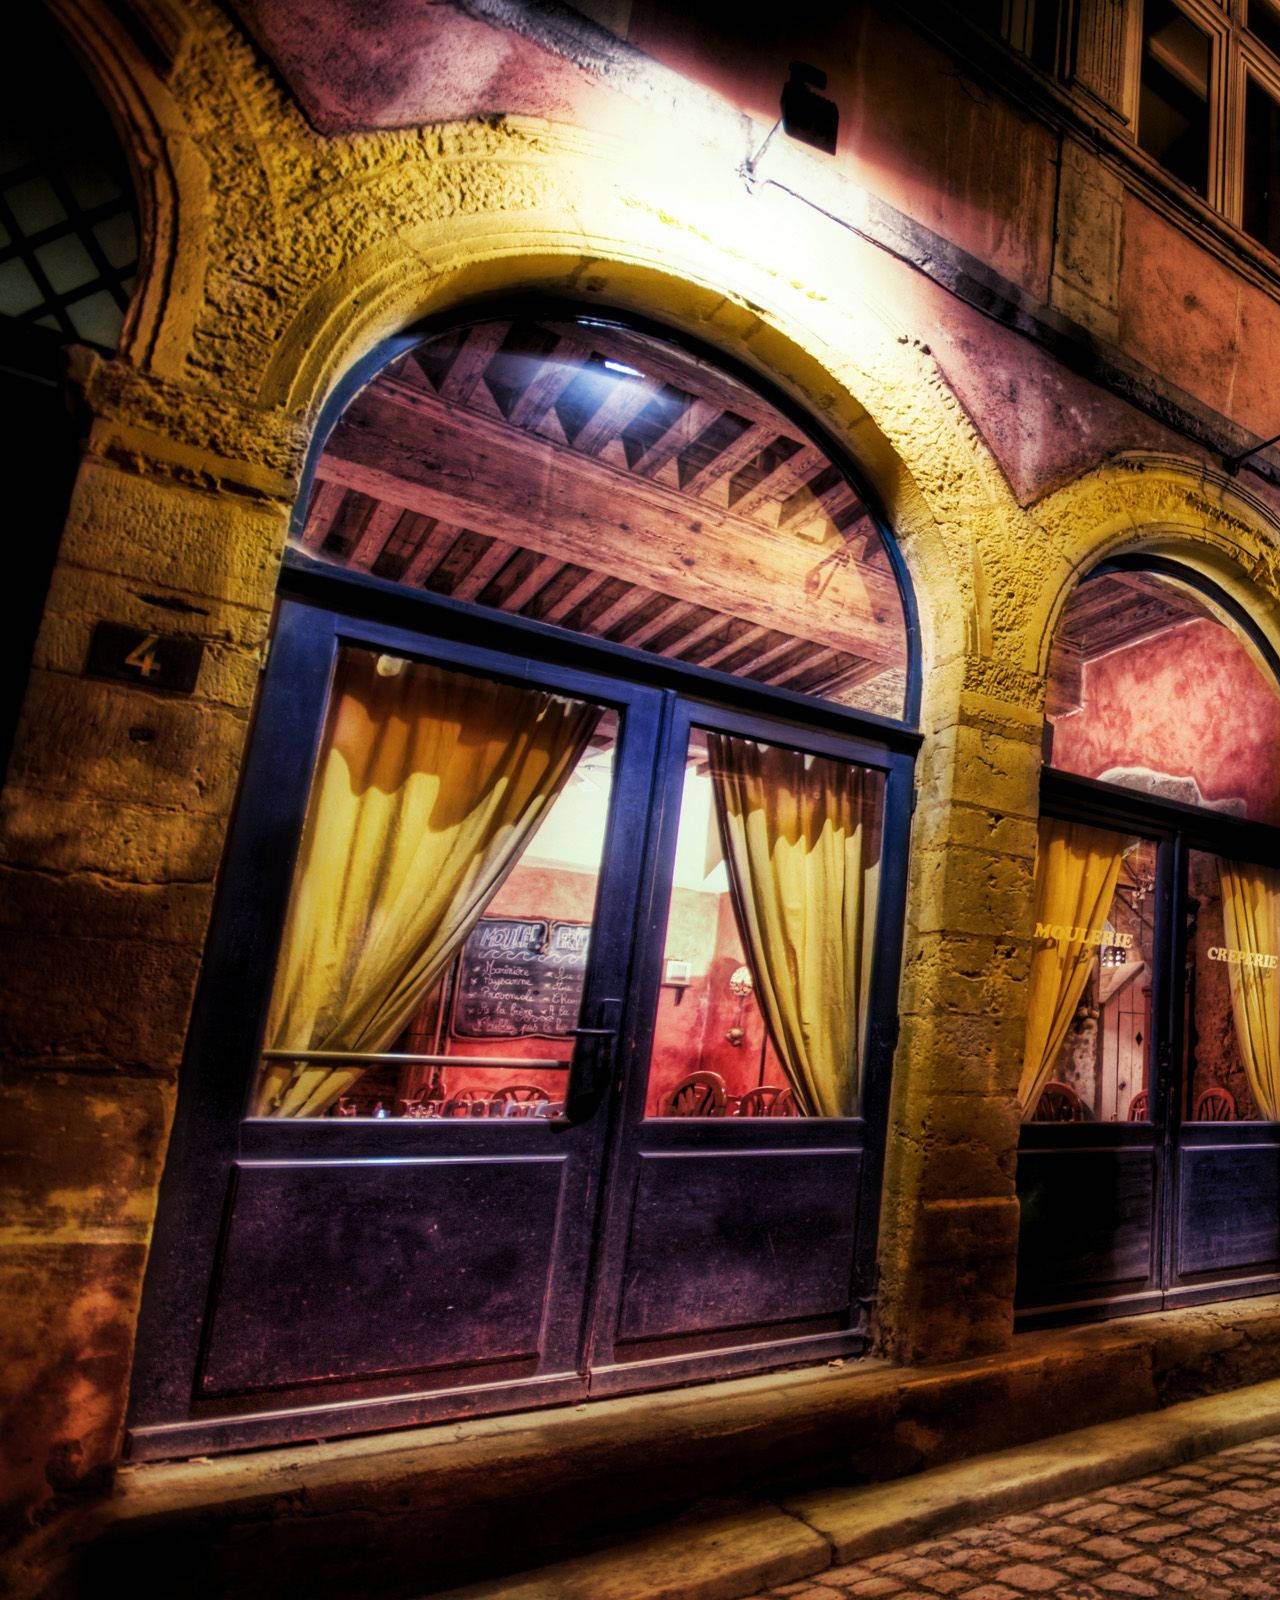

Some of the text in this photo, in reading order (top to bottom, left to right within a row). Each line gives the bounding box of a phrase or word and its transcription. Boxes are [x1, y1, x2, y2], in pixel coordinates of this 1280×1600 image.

[124, 633, 160, 677] 4
[1033, 922, 1134, 950] MOULERIE
[1207, 946, 1279, 968] CREPERIE
